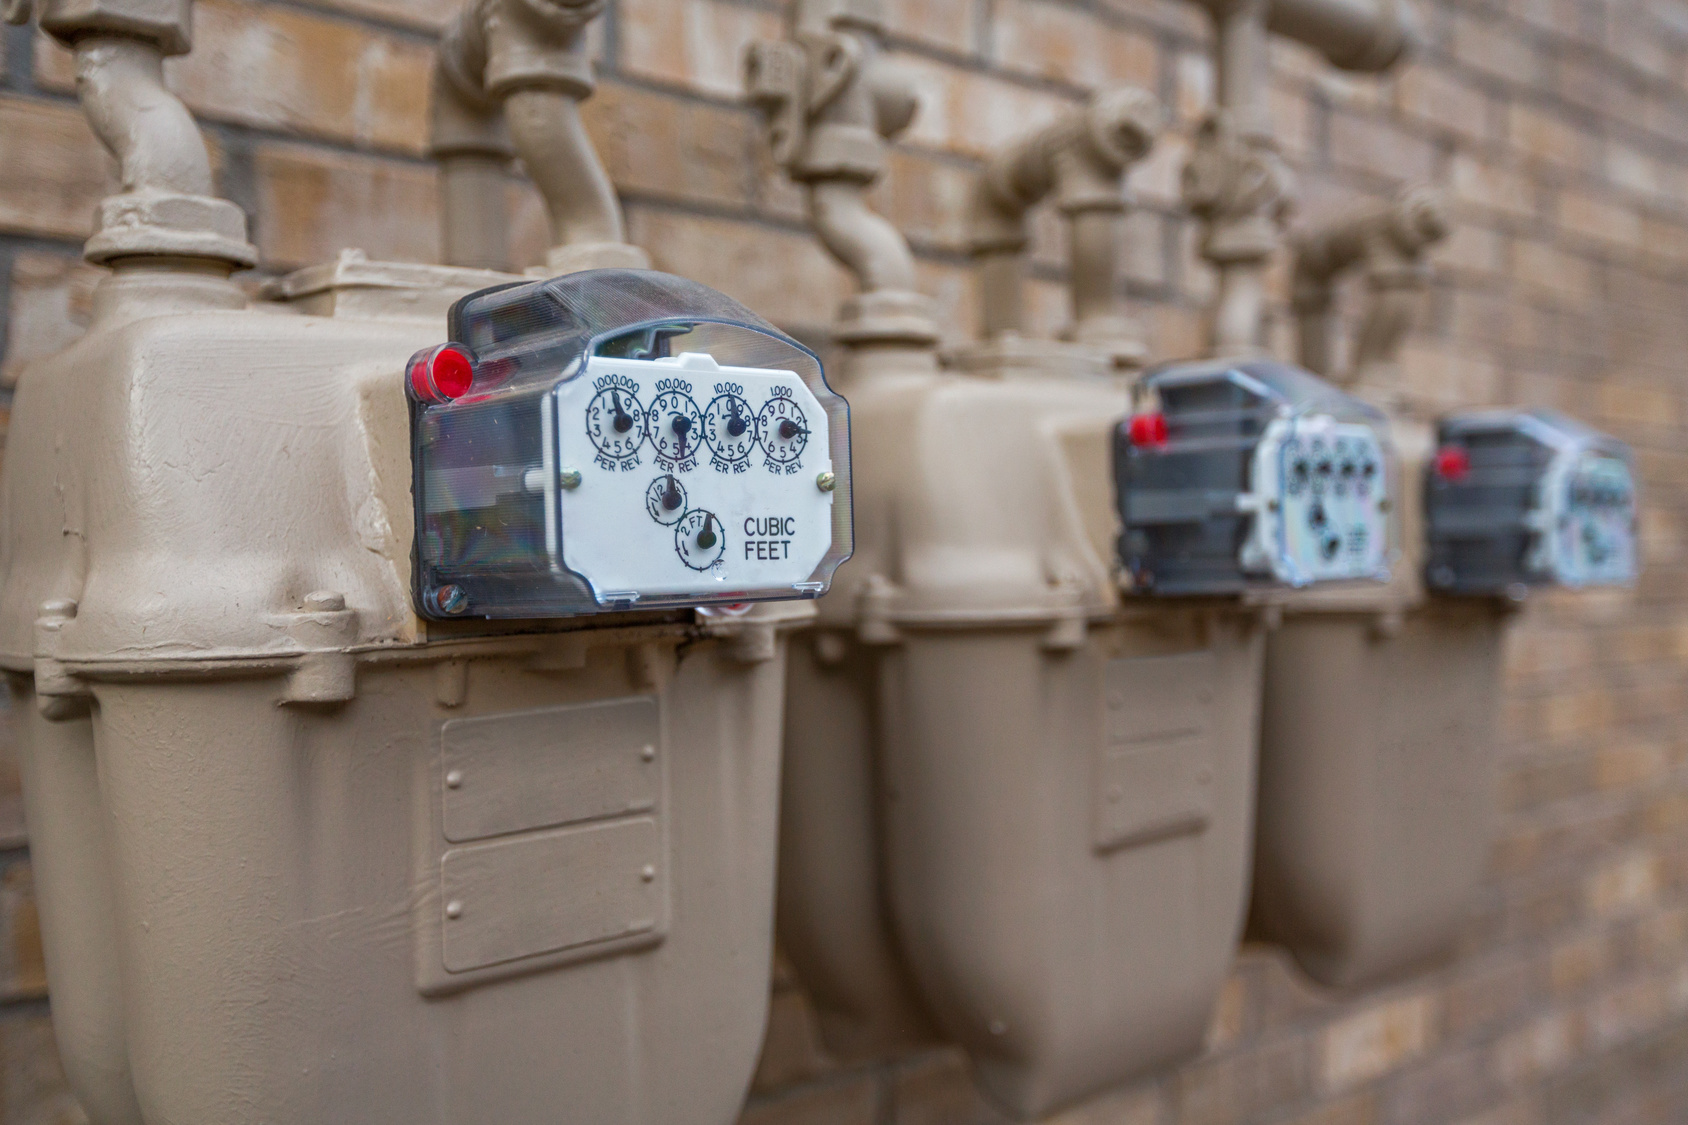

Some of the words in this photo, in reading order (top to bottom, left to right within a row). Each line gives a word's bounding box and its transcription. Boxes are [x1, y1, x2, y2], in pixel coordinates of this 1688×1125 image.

[592, 374, 639, 393] 1,000,000
[655, 378, 692, 393] 100,000
[713, 382, 743, 395] 10,000
[770, 386, 792, 398] 1,000
[624, 398, 632, 410] 9
[660, 399, 667, 412] 9
[671, 396, 678, 409] 0
[778, 403, 785, 414] 0
[592, 407, 600, 420] 2
[633, 409, 640, 422] 8
[652, 409, 659, 422] 8
[736, 404, 743, 416] 9
[768, 405, 775, 417] 9
[691, 411, 697, 423] 2
[708, 413, 716, 426] 2
[744, 415, 751, 427] 8
[761, 415, 768, 427] 8
[796, 416, 802, 428] 2
[593, 424, 601, 437] 3
[636, 425, 642, 438] 7
[653, 426, 660, 439] 7
[691, 428, 699, 441] 3
[709, 429, 716, 441] 3
[747, 430, 753, 442] 7
[763, 431, 768, 443] 7
[602, 437, 611, 450] 4
[614, 441, 621, 454] 5
[625, 437, 633, 450] 6
[660, 437, 667, 449] 6
[673, 442, 680, 455] 5
[717, 441, 725, 453] 4
[737, 441, 745, 453] 6
[768, 441, 775, 453] 6
[790, 441, 797, 453] 4
[728, 444, 735, 457] 5
[780, 446, 786, 458] 5
[594, 454, 616, 472] PER
[621, 455, 642, 472] REV.
[653, 455, 674, 473] PER
[679, 457, 699, 473] REV.
[709, 456, 729, 474] PER
[733, 459, 752, 474] REV.
[763, 458, 782, 475] PER
[785, 460, 804, 475] REV.
[681, 526, 690, 536] 2
[744, 517, 795, 536] CUBIC
[745, 540, 791, 560] FEET
